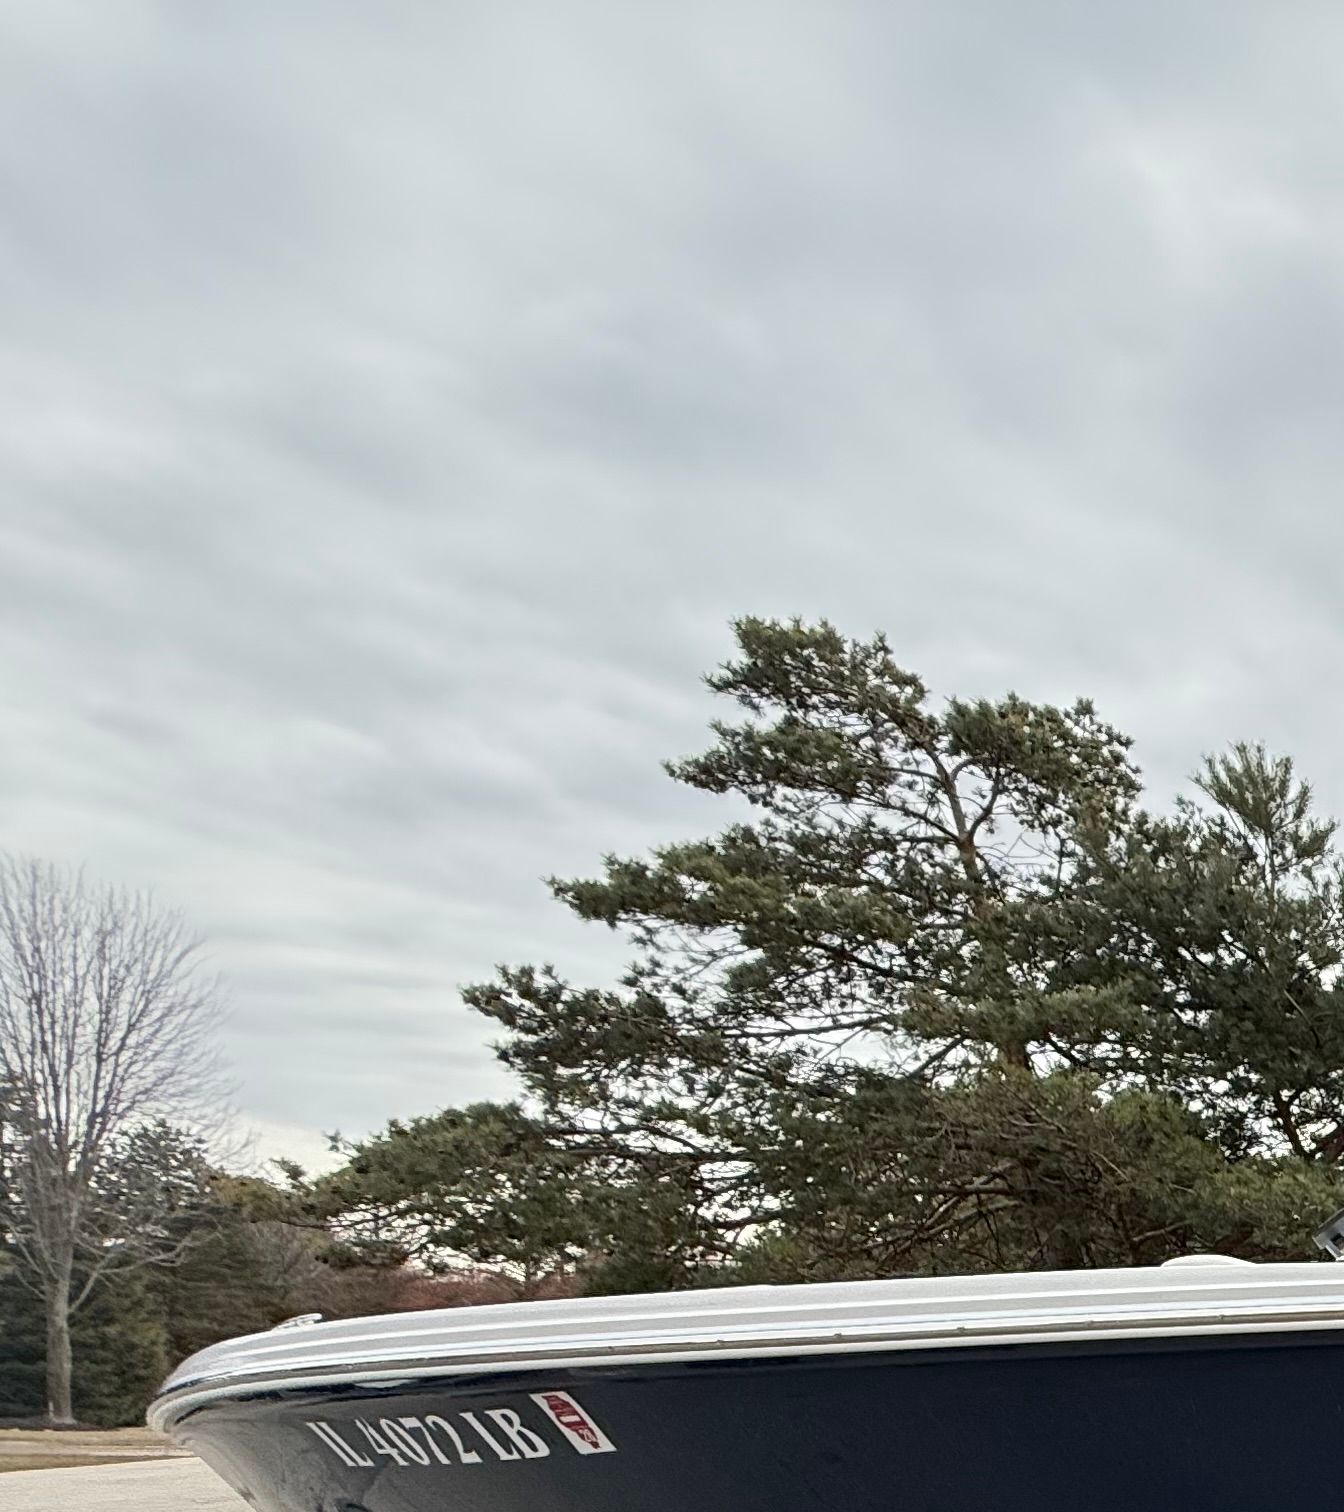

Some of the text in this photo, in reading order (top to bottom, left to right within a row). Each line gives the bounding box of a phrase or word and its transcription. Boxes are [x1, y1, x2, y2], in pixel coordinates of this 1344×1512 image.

[305, 1408, 550, 1467] IL 4072 LB
